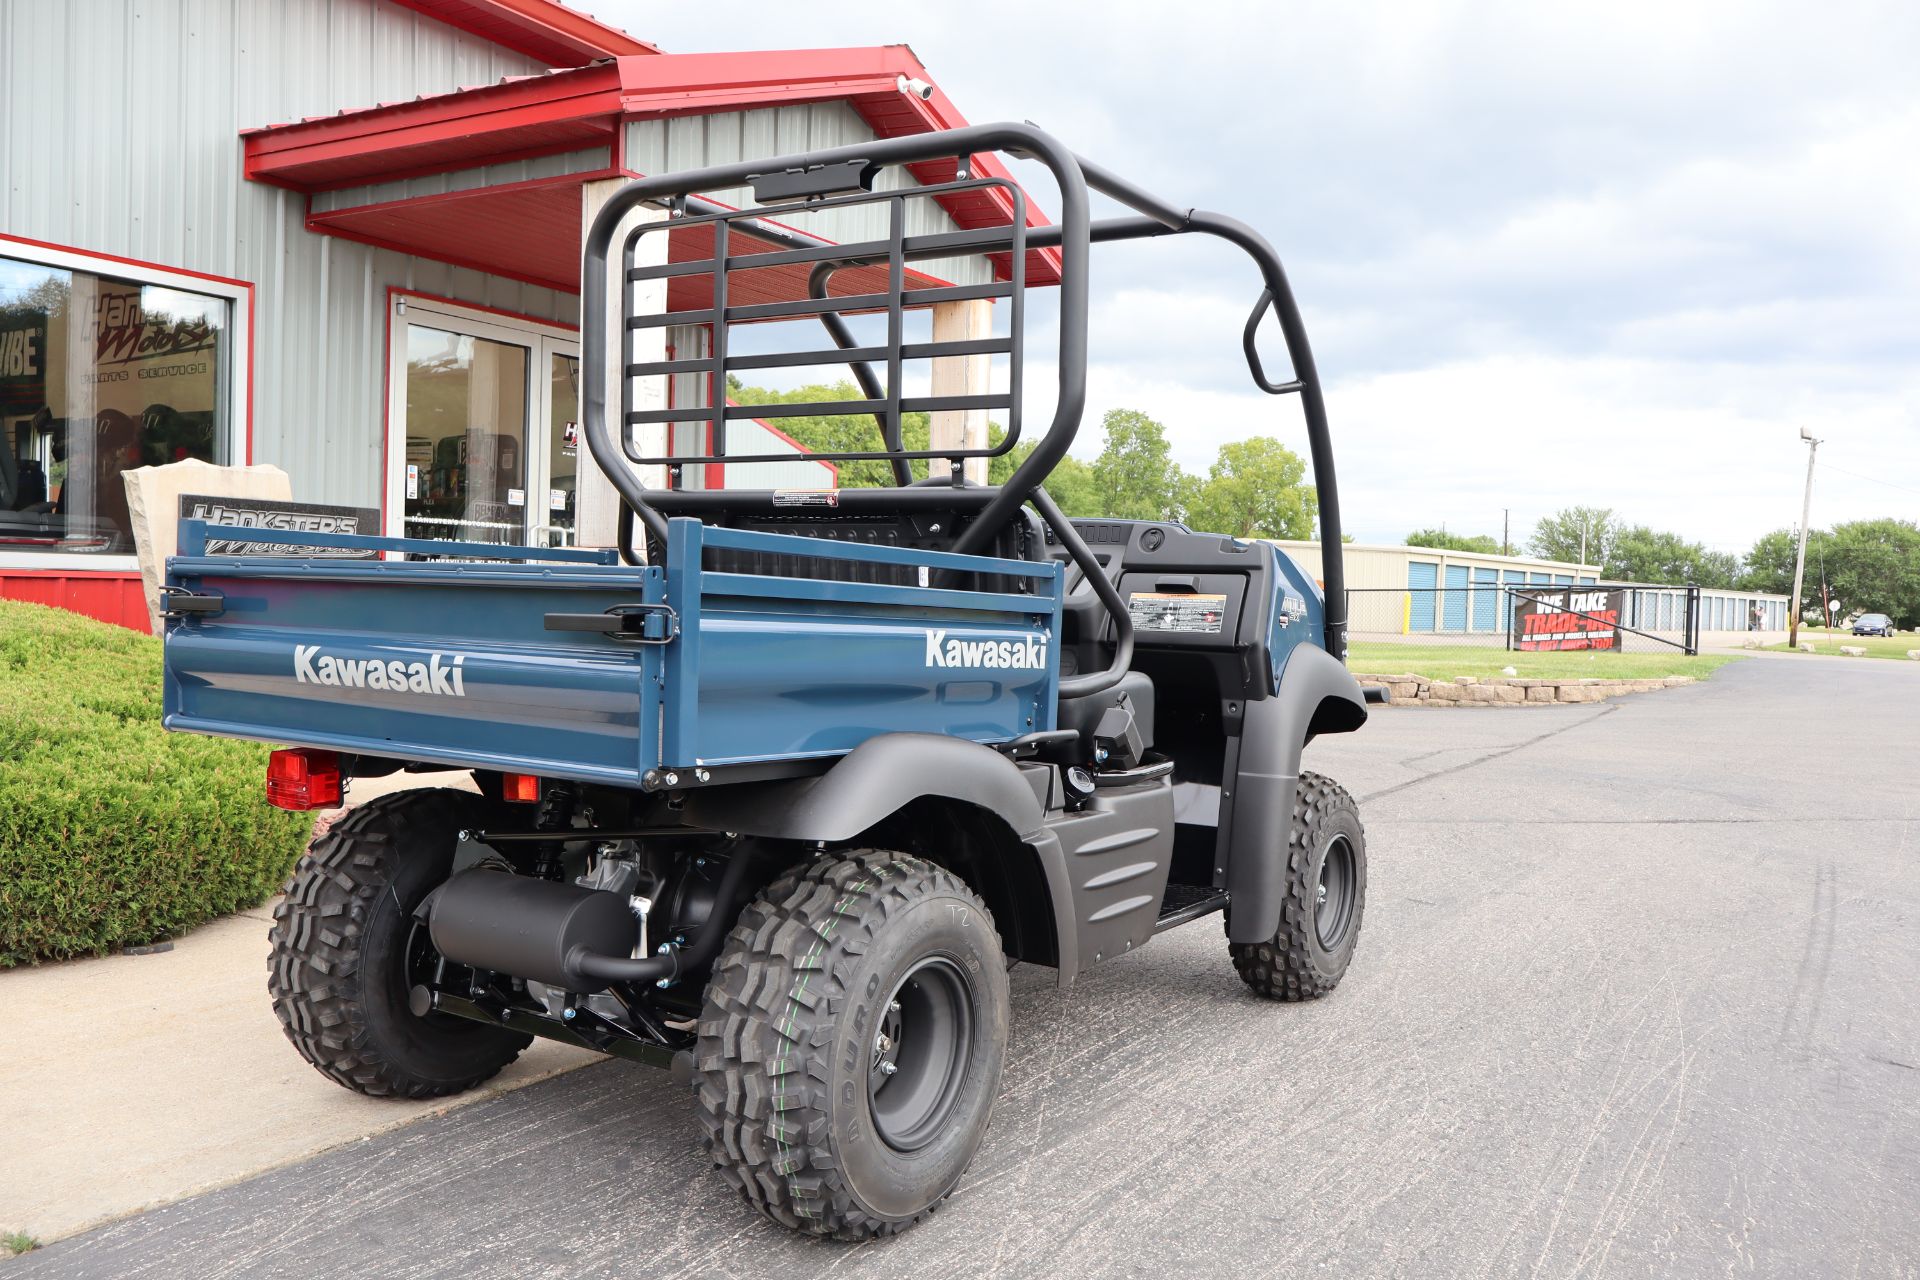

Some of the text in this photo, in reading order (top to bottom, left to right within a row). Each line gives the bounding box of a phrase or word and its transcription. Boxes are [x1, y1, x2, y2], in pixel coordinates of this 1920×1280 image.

[138, 363, 207, 380] SERVICE
[1537, 592, 1609, 614] WE TAKE
[1524, 610, 1617, 634] TRADE-INS
[925, 629, 1047, 670] Kawasaki
[294, 644, 466, 697] Kawasaki
[945, 904, 971, 927] T2
